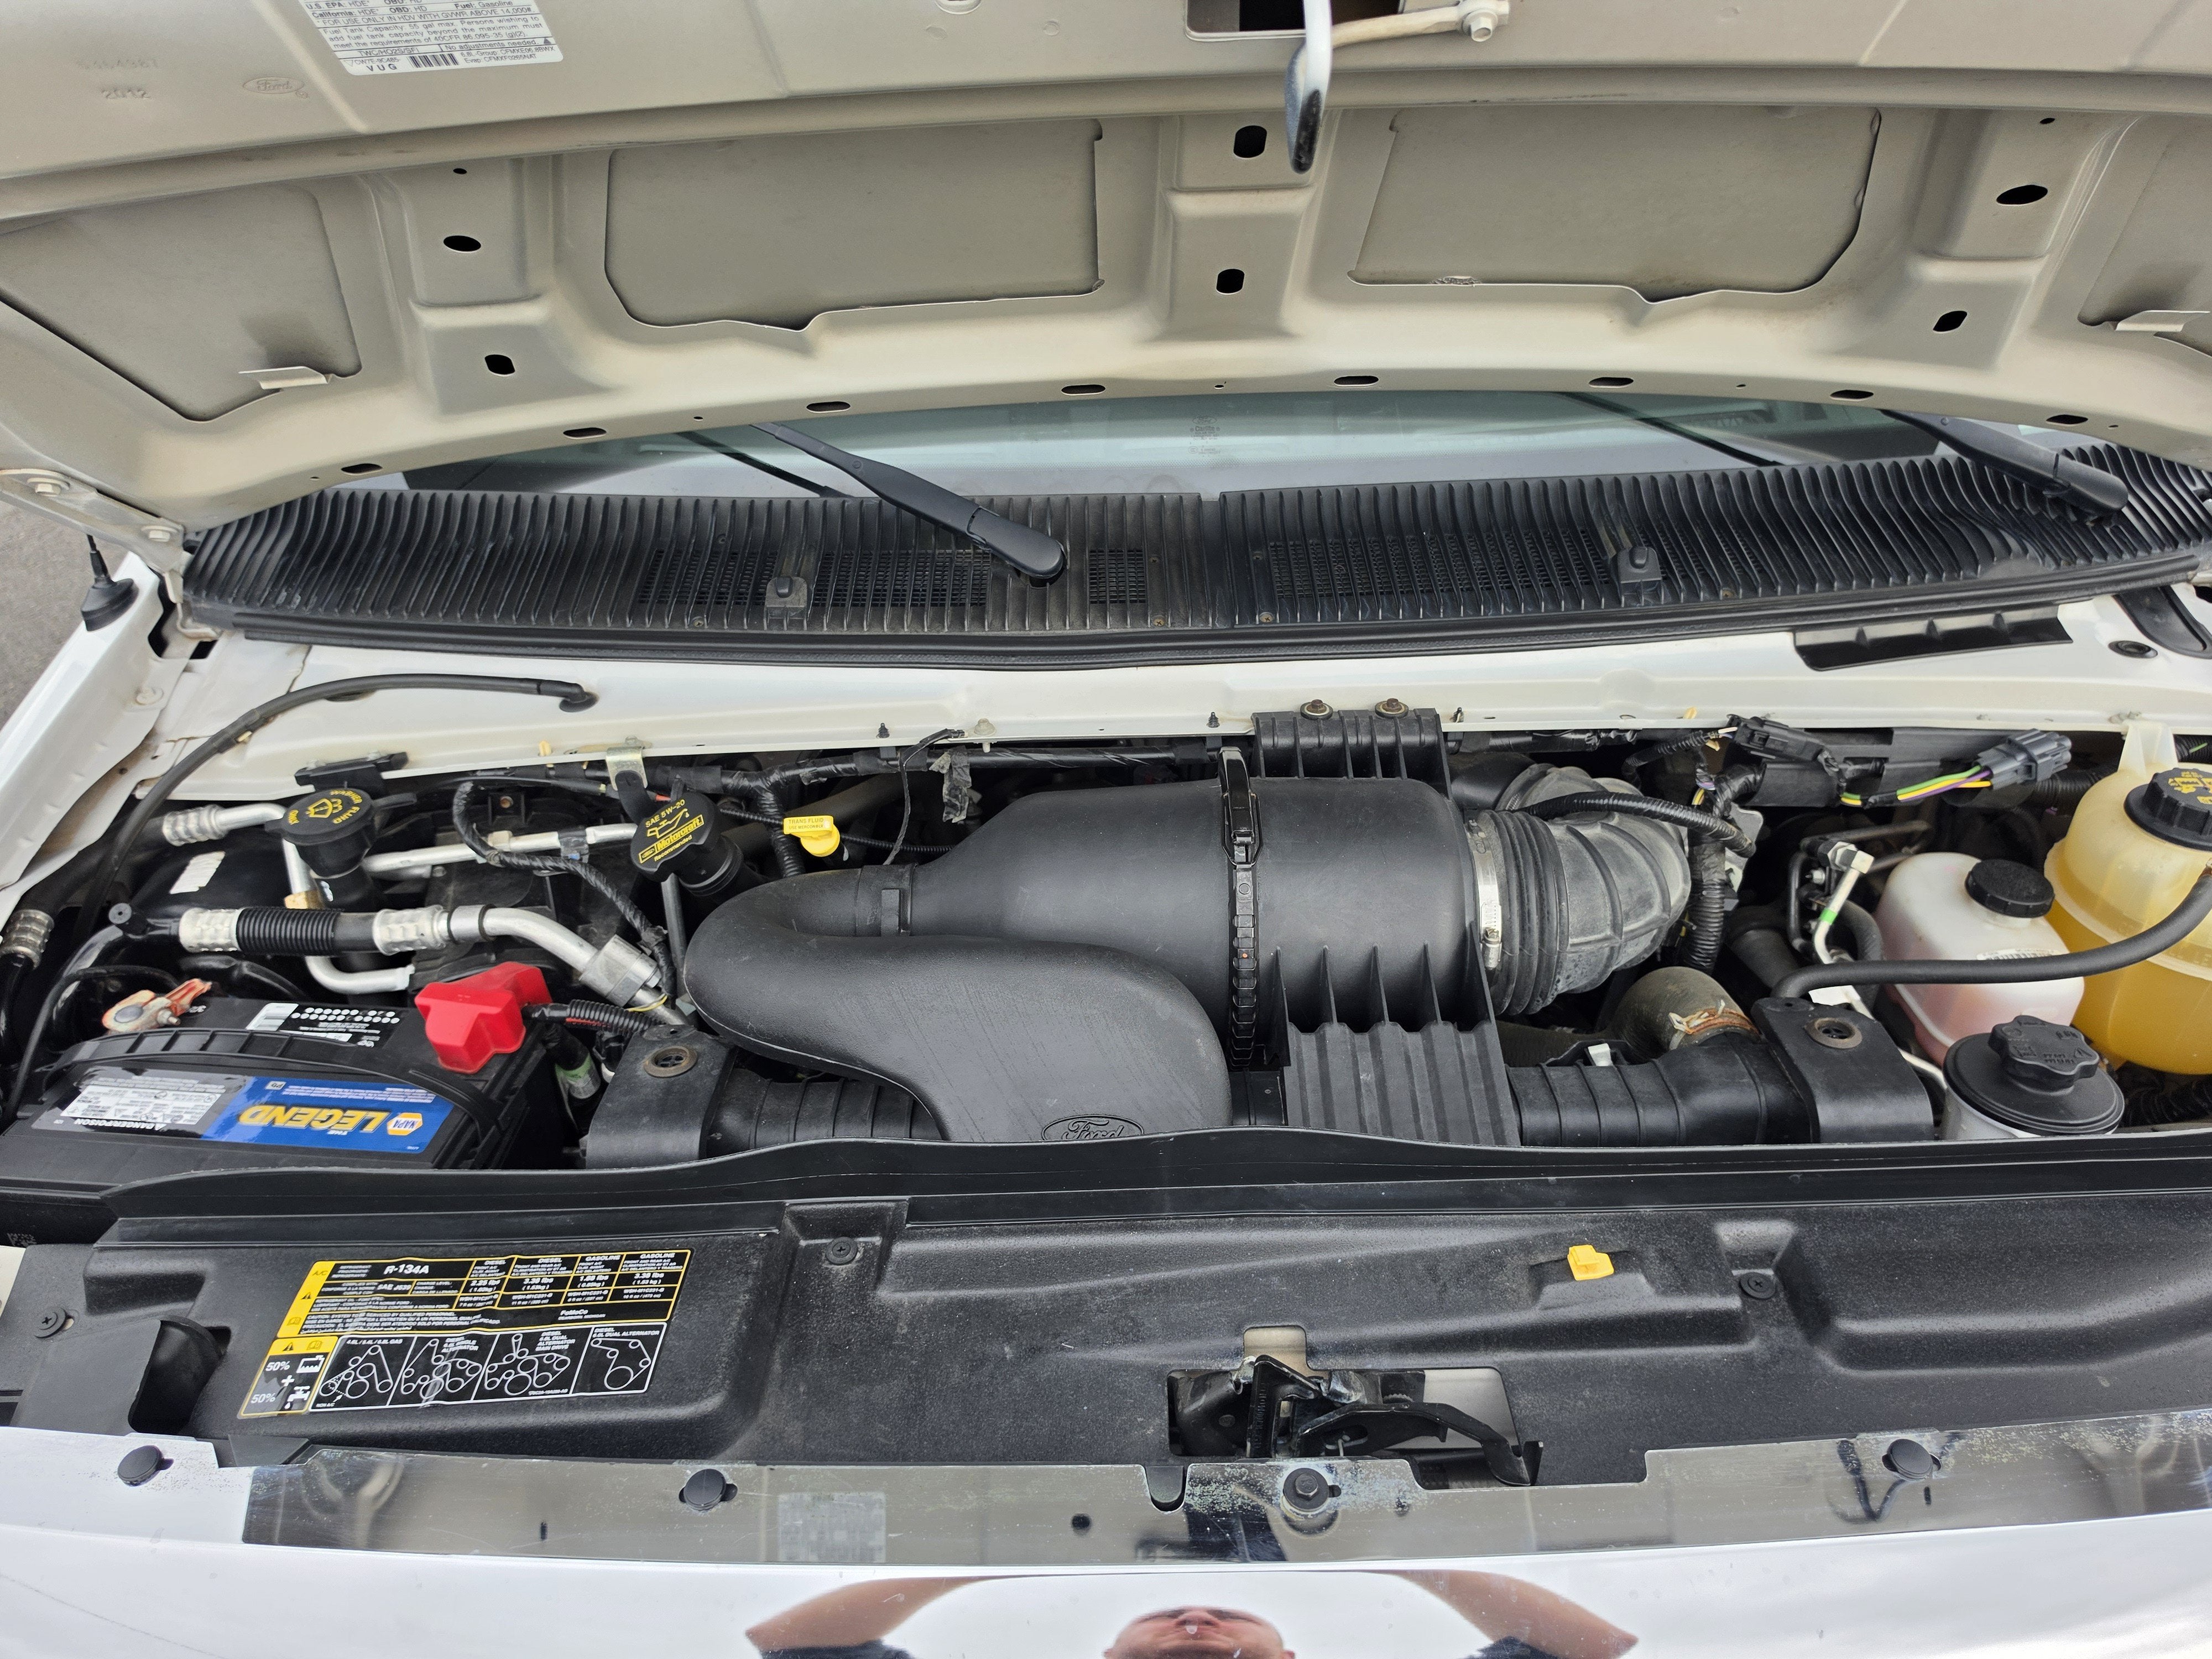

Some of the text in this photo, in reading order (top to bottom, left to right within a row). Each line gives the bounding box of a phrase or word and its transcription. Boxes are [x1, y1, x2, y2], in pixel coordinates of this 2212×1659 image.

[370, 38, 422, 47] requirements
[462, 32, 504, 40] 86.095-35
[358, 48, 420, 57] TWC/HO2S/SFI
[459, 42, 500, 51] adjustments
[257, 79, 293, 91] Ford
[330, 789, 363, 804] WASHER
[332, 806, 361, 824] FLUID
[645, 799, 685, 828] SAE 5W-20
[656, 818, 702, 852] Motorcraft
[654, 834, 692, 862] Recommended
[238, 1105, 391, 1134] LEGEND
[393, 1118, 418, 1131] NAPA
[383, 1264, 429, 1275] R-134A
[377, 1283, 394, 1291] SAE
[265, 1360, 291, 1372] 50%
[251, 1392, 276, 1404] 50%
